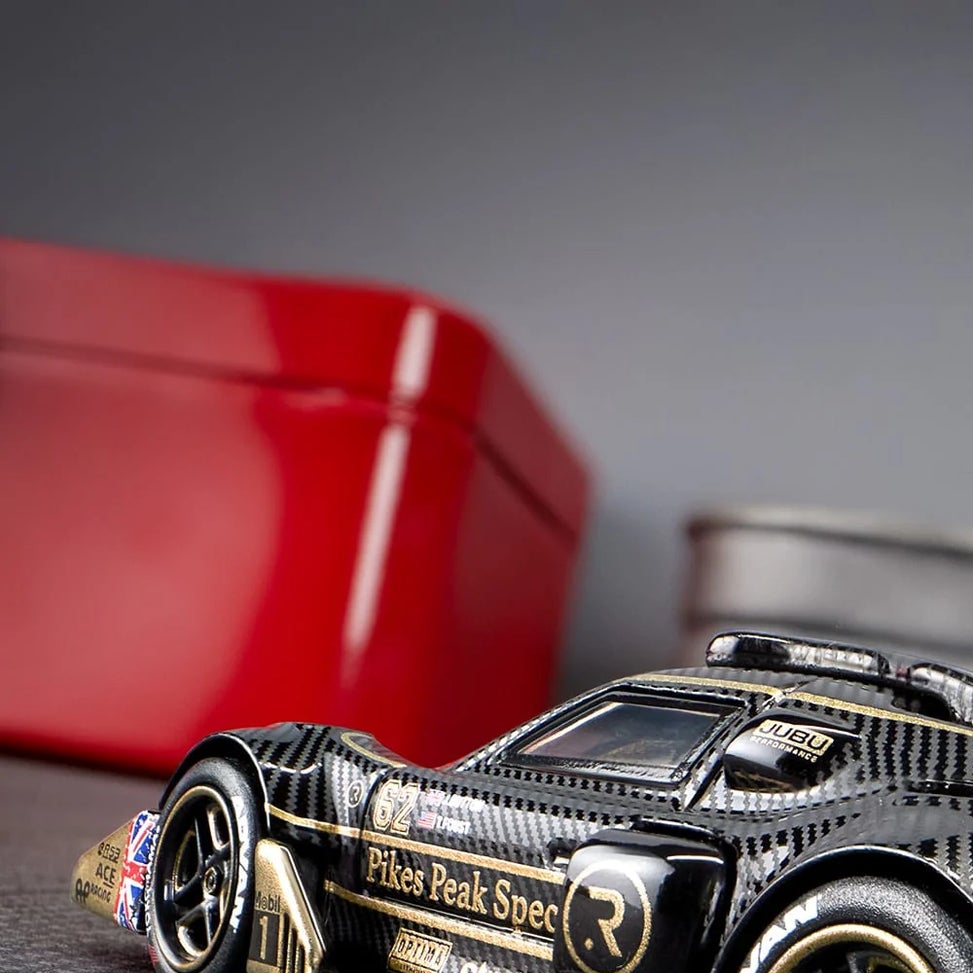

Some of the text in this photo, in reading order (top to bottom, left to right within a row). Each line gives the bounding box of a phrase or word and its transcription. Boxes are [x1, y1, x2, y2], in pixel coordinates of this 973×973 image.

[750, 736, 819, 763] PERFORMANCE
[760, 723, 829, 751] JUBU
[372, 779, 420, 835] 62
[366, 846, 558, 935] Pikes Peak Spec
[259, 915, 269, 960] 1
[397, 939, 441, 966] OPTIMA
